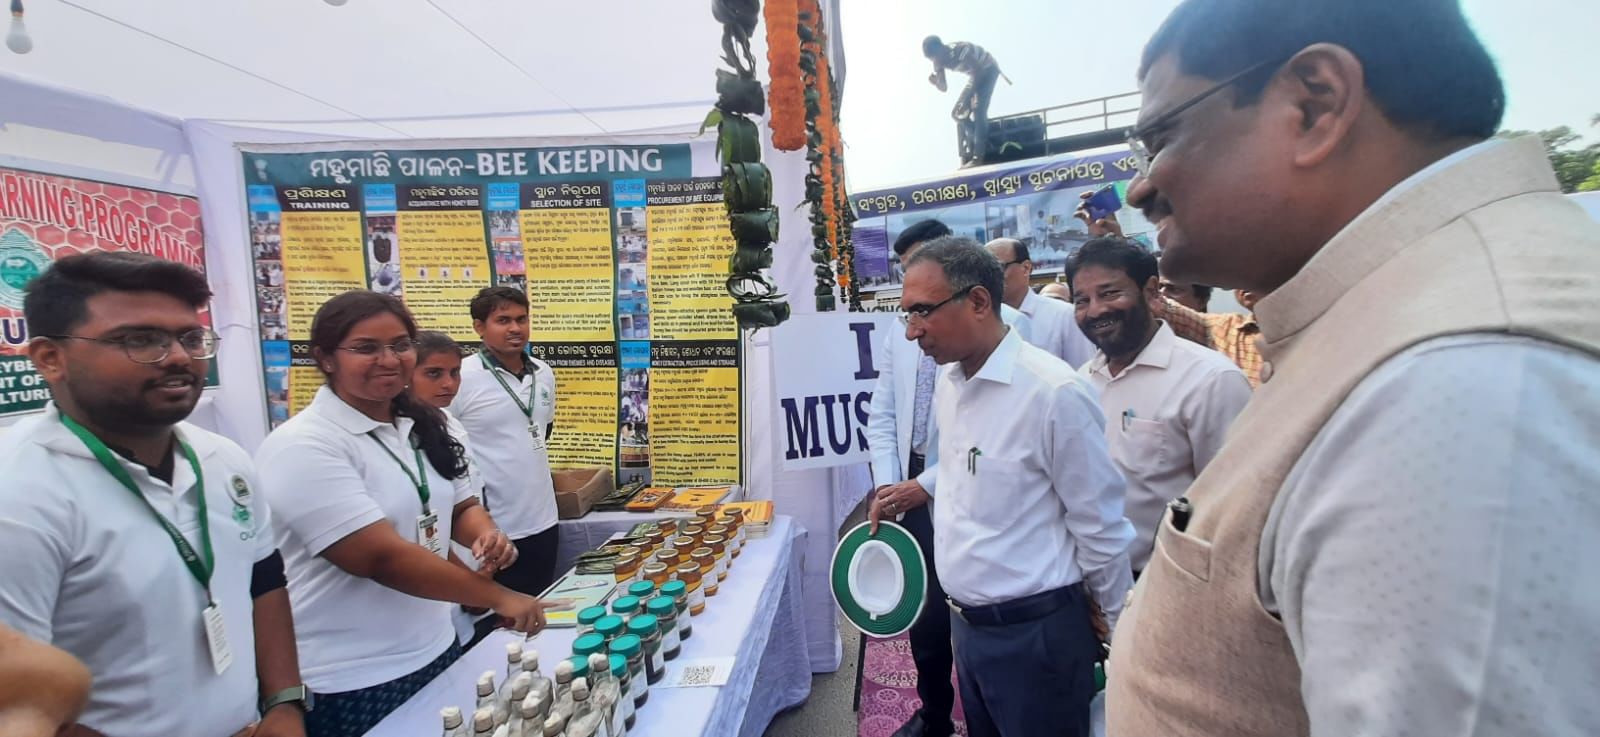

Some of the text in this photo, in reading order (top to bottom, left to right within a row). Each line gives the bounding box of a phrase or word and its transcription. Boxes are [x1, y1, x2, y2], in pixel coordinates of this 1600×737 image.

[310, 152, 391, 184] ମହୁମାଛି
[538, 148, 662, 175] KEEPING
[284, 186, 347, 200] ପ୍ରଶିକ୍ଷଣ
[534, 186, 557, 199] ସ୍ଥାନ
[858, 193, 906, 213] ସଂଗ୍ରହ,
[912, 184, 976, 206] ପରୀକ୍ଷଣ,
[1029, 161, 1105, 191] ସୂଚନାପତ୍ର
[530, 198, 602, 208] SELECTION OF SITE
[548, 346, 555, 355] ଓ
[557, 345, 588, 358] ରୋଗରୁ
[589, 345, 614, 358] ସୁରକ୍ଷା
[848, 322, 880, 381] I
[21, 374, 44, 386] OF
